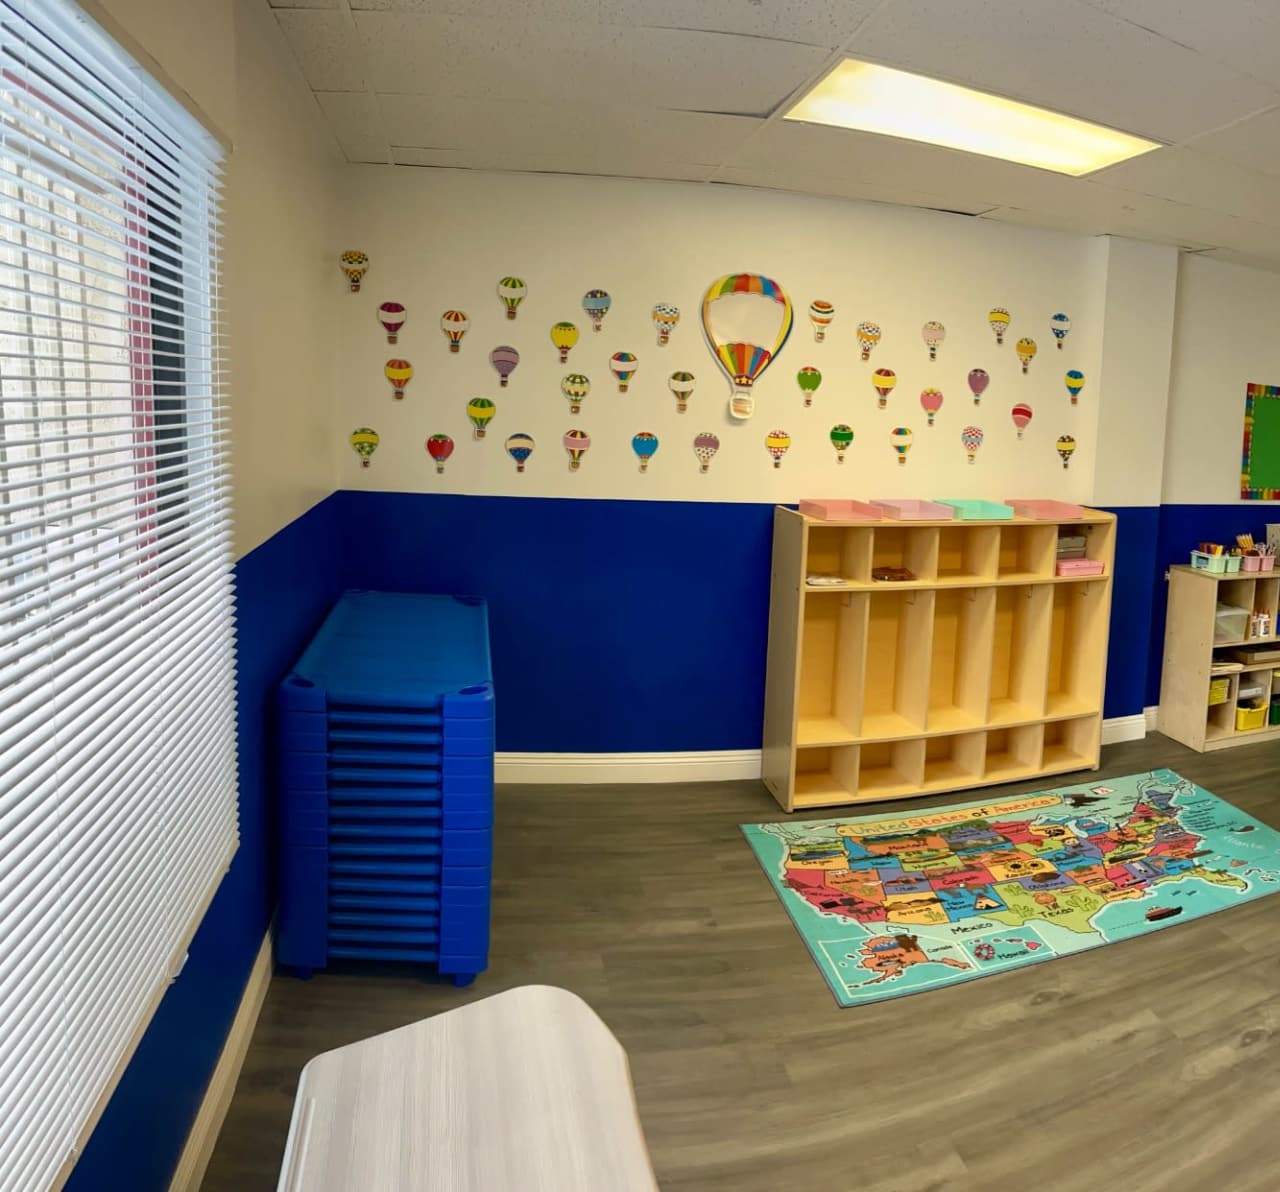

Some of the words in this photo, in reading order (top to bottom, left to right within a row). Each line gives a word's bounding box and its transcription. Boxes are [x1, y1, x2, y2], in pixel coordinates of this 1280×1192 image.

[851, 820, 909, 835] United
[908, 813, 967, 828] States
[971, 808, 990, 818] of
[994, 799, 1050, 813] America
[1037, 906, 1075, 919] Texas
[951, 921, 993, 935] Mexico
